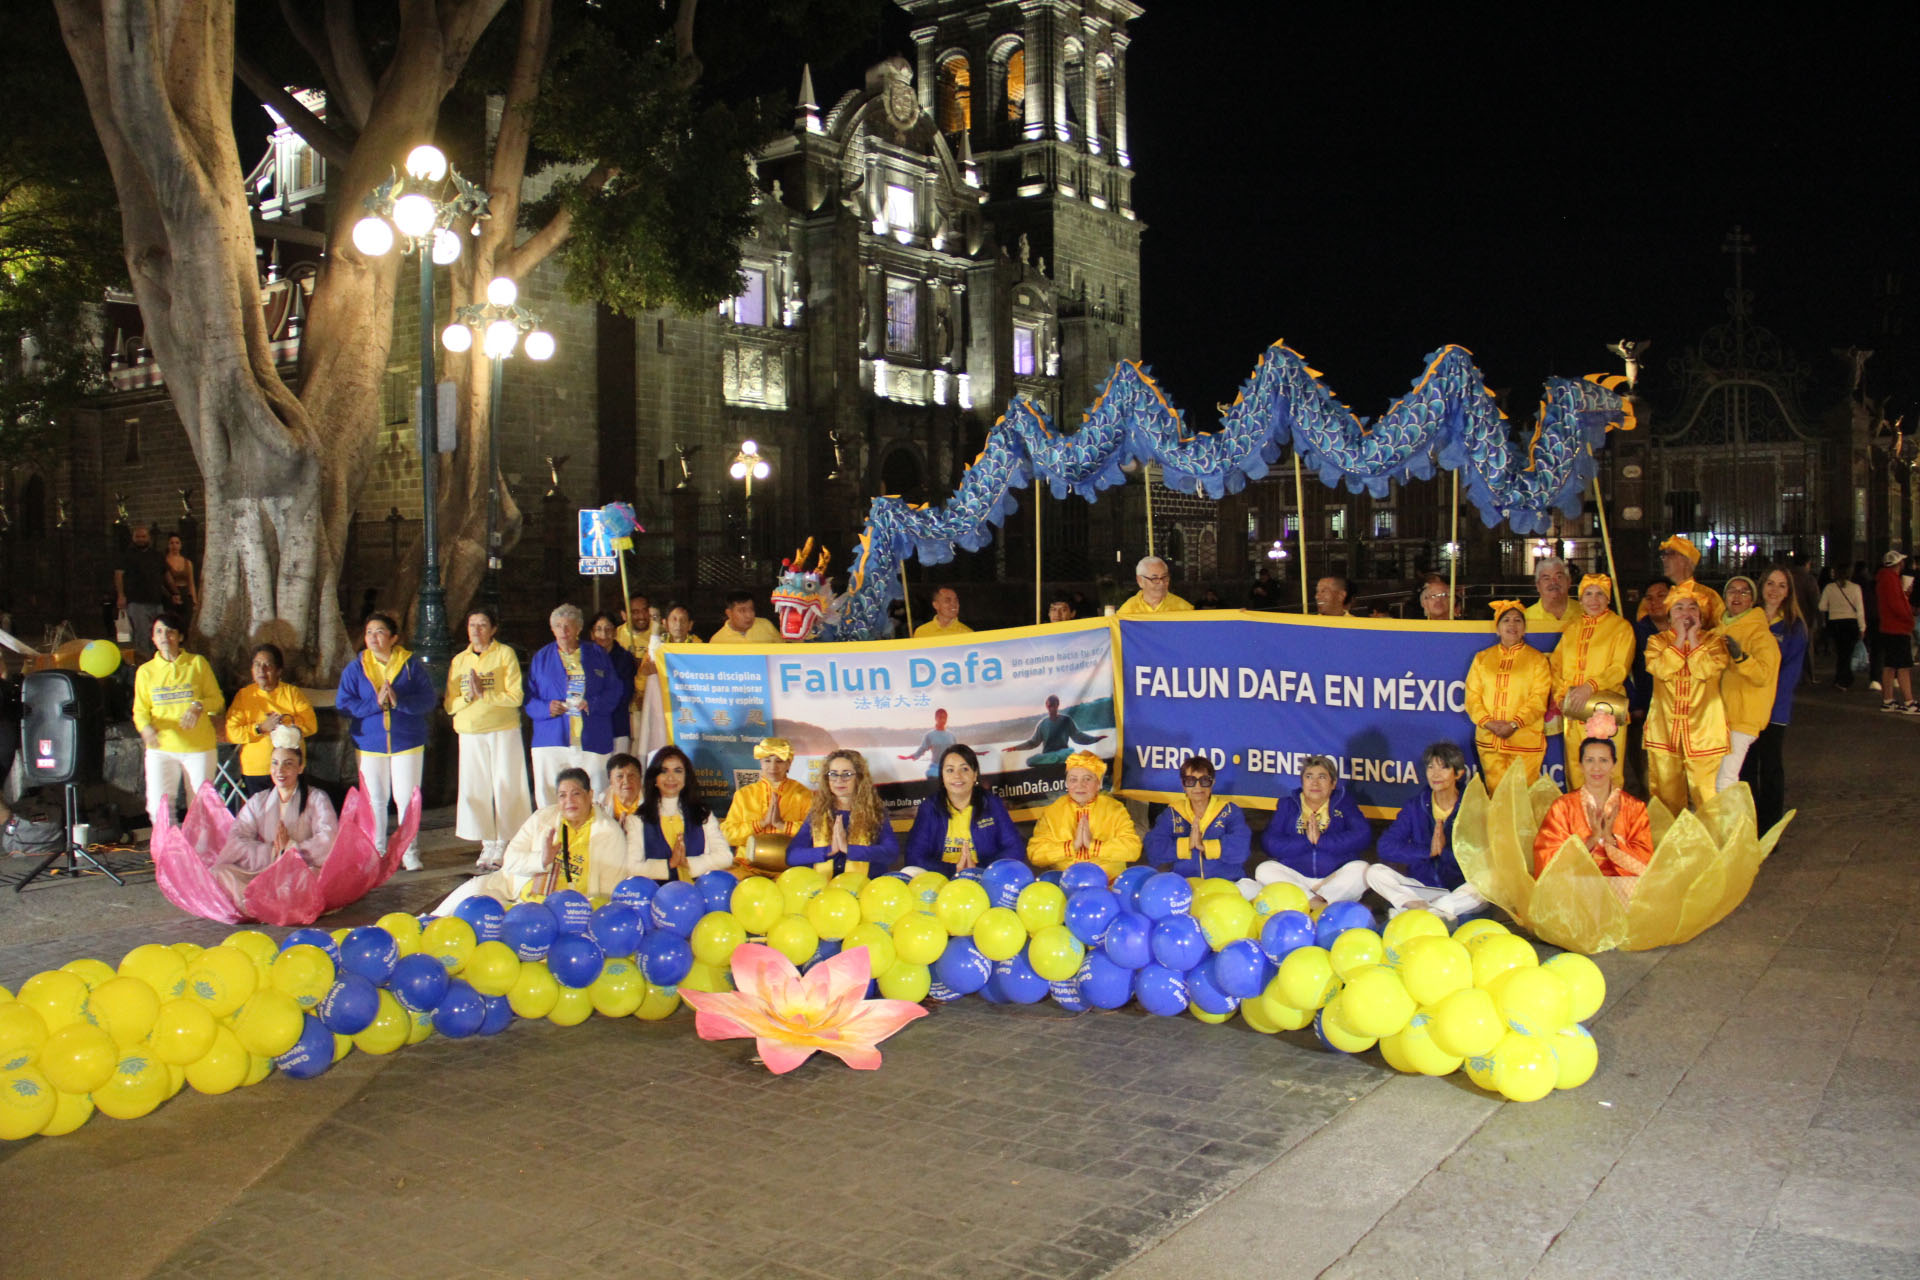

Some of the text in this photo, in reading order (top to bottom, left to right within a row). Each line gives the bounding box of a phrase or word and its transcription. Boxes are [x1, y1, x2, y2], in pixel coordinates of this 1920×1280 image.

[779, 651, 1003, 693] Falun Dafa
[1025, 655, 1055, 665] camino
[673, 669, 762, 682] Poderosa disciplina
[1012, 666, 1046, 679] original
[1135, 665, 1466, 713] FALUN DAFA EN MÉXIC
[1247, 749, 1420, 785] BENELENCIA
